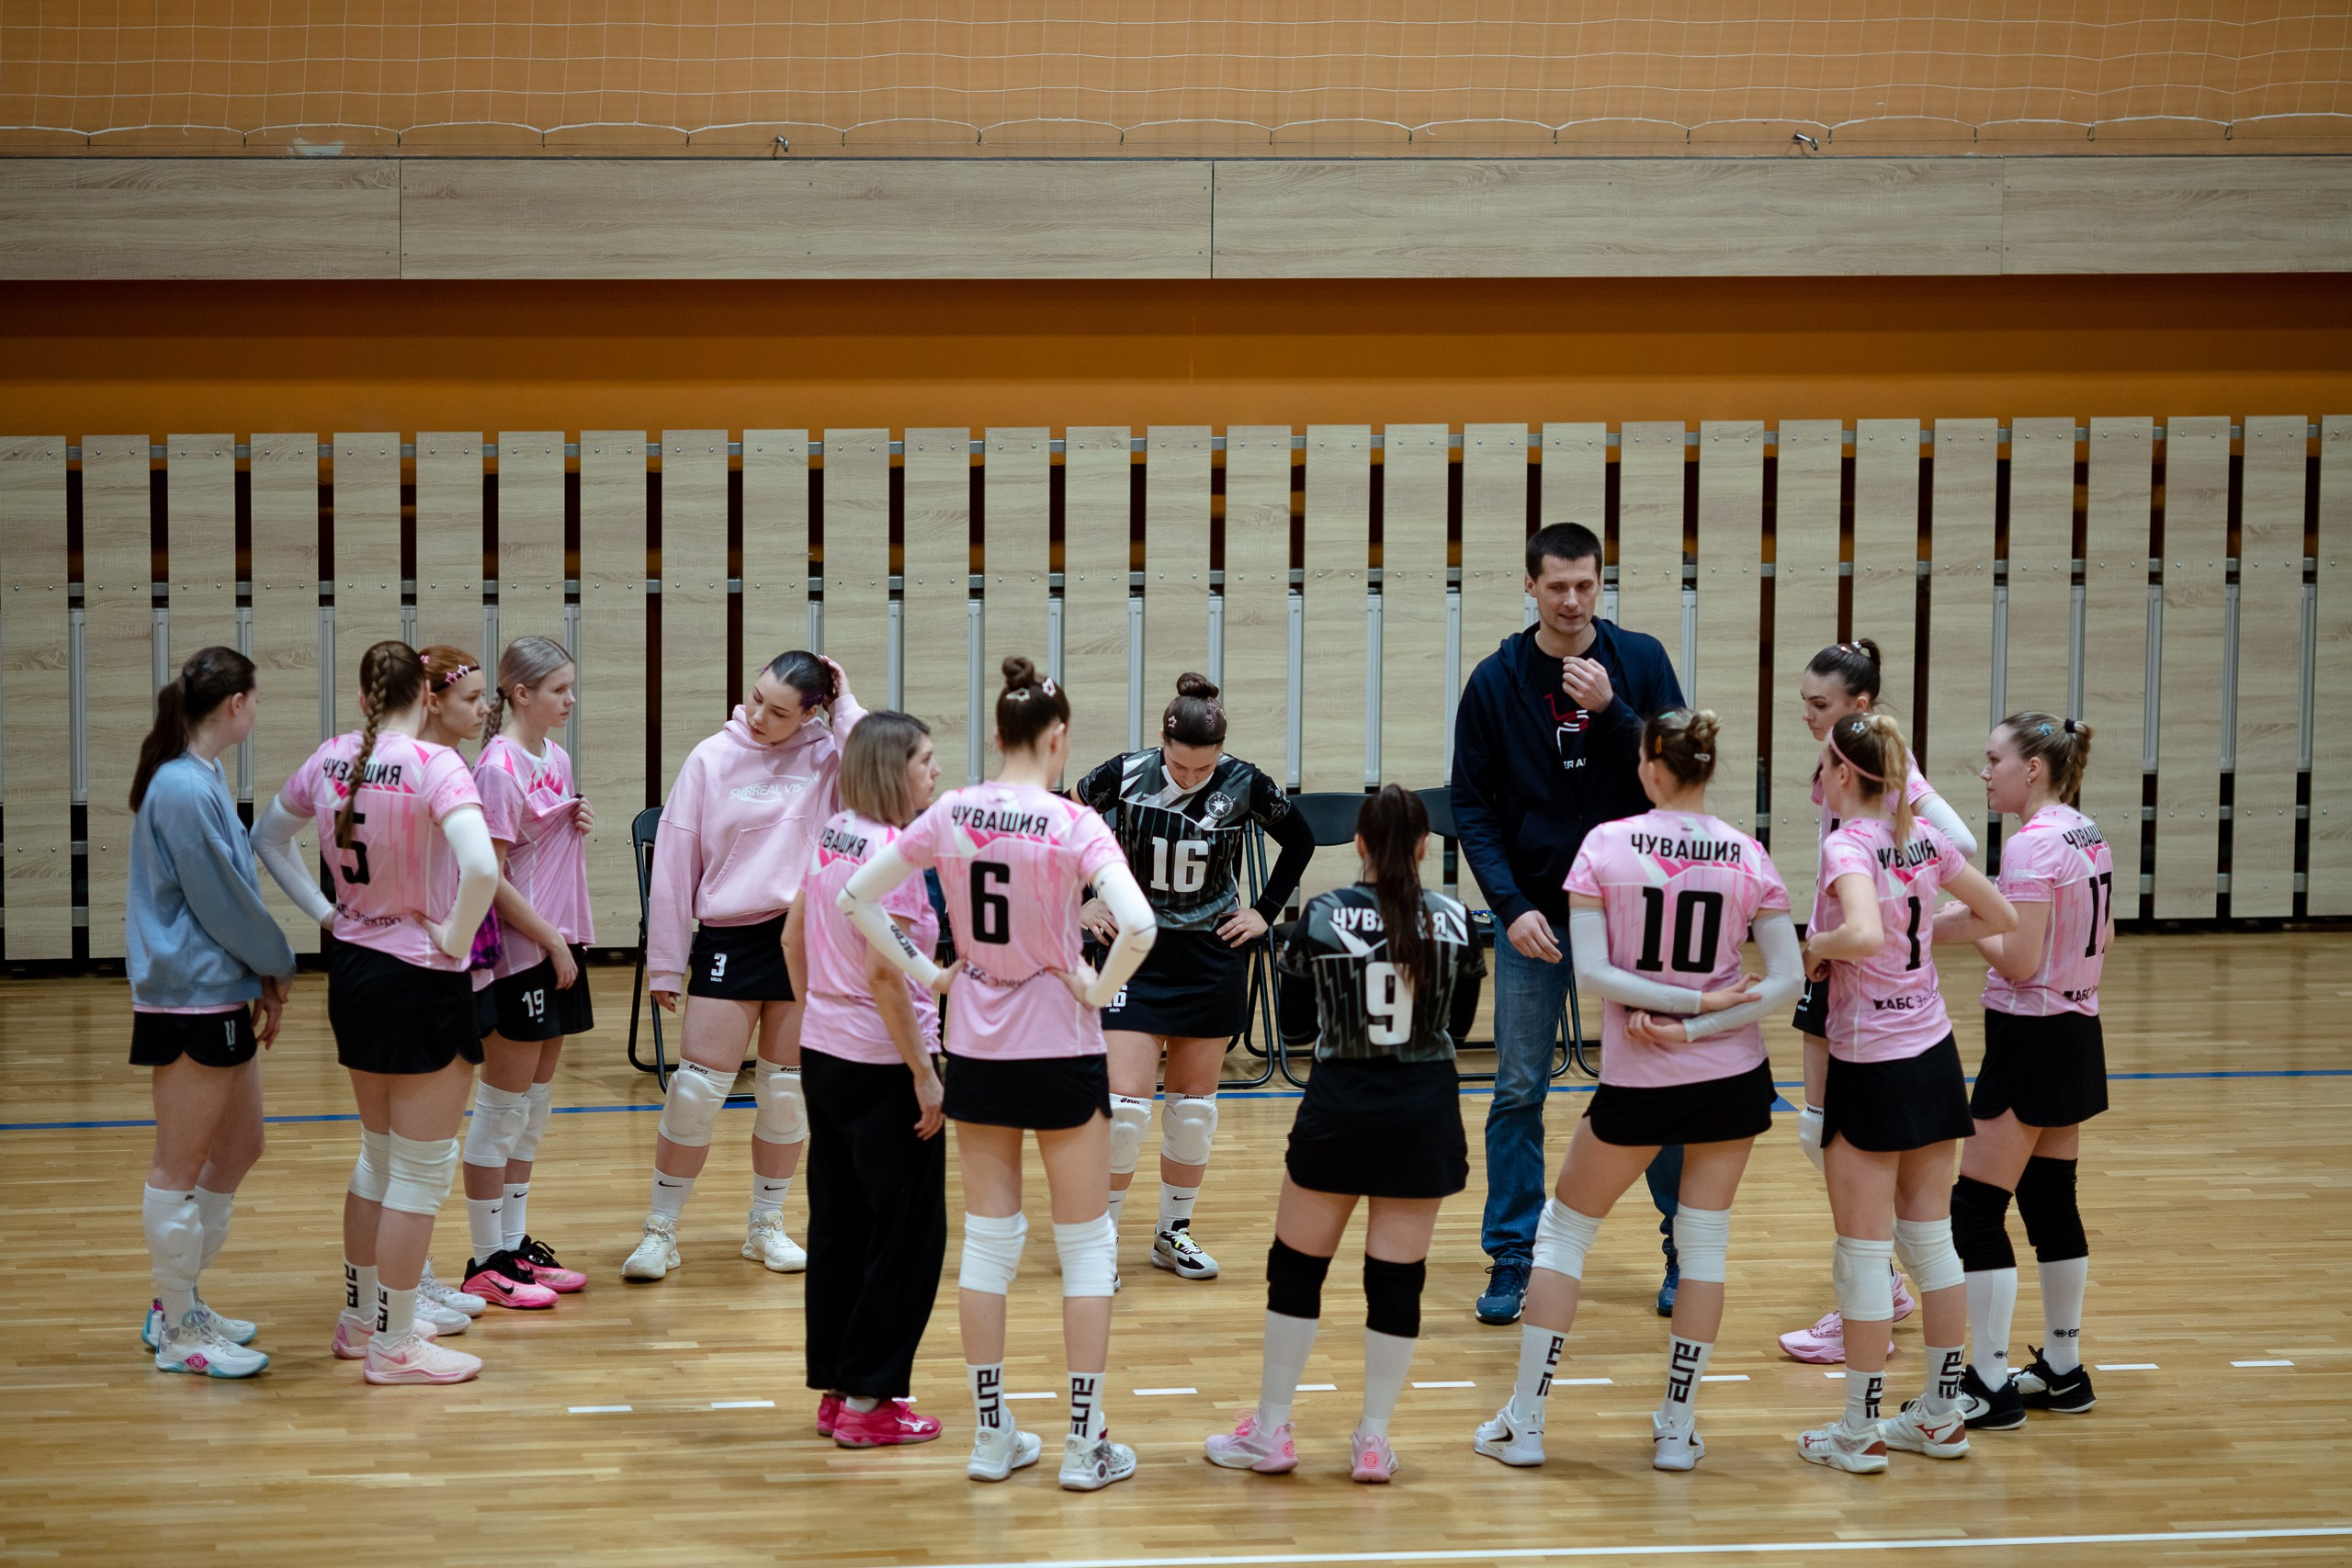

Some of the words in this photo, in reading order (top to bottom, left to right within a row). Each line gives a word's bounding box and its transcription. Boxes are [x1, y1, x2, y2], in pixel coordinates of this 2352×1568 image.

[323, 758, 401, 785] ЧУВШИЯ
[334, 810, 369, 886] 5
[952, 806, 1048, 836] ЧУВАШИЯ
[1631, 833, 1741, 863] ЧУВАШИЯ
[1150, 836, 1209, 893] 16
[970, 861, 1010, 944] 6
[1636, 886, 1724, 974] 10
[1905, 896, 1921, 972] 1
[711, 953, 727, 976] 3
[522, 988, 544, 1017] 19
[1105, 984, 1127, 1007] 6
[1365, 962, 1415, 1045] 9
[977, 1368, 1000, 1429] ELITE
[1668, 1341, 1702, 1404] ELITE
